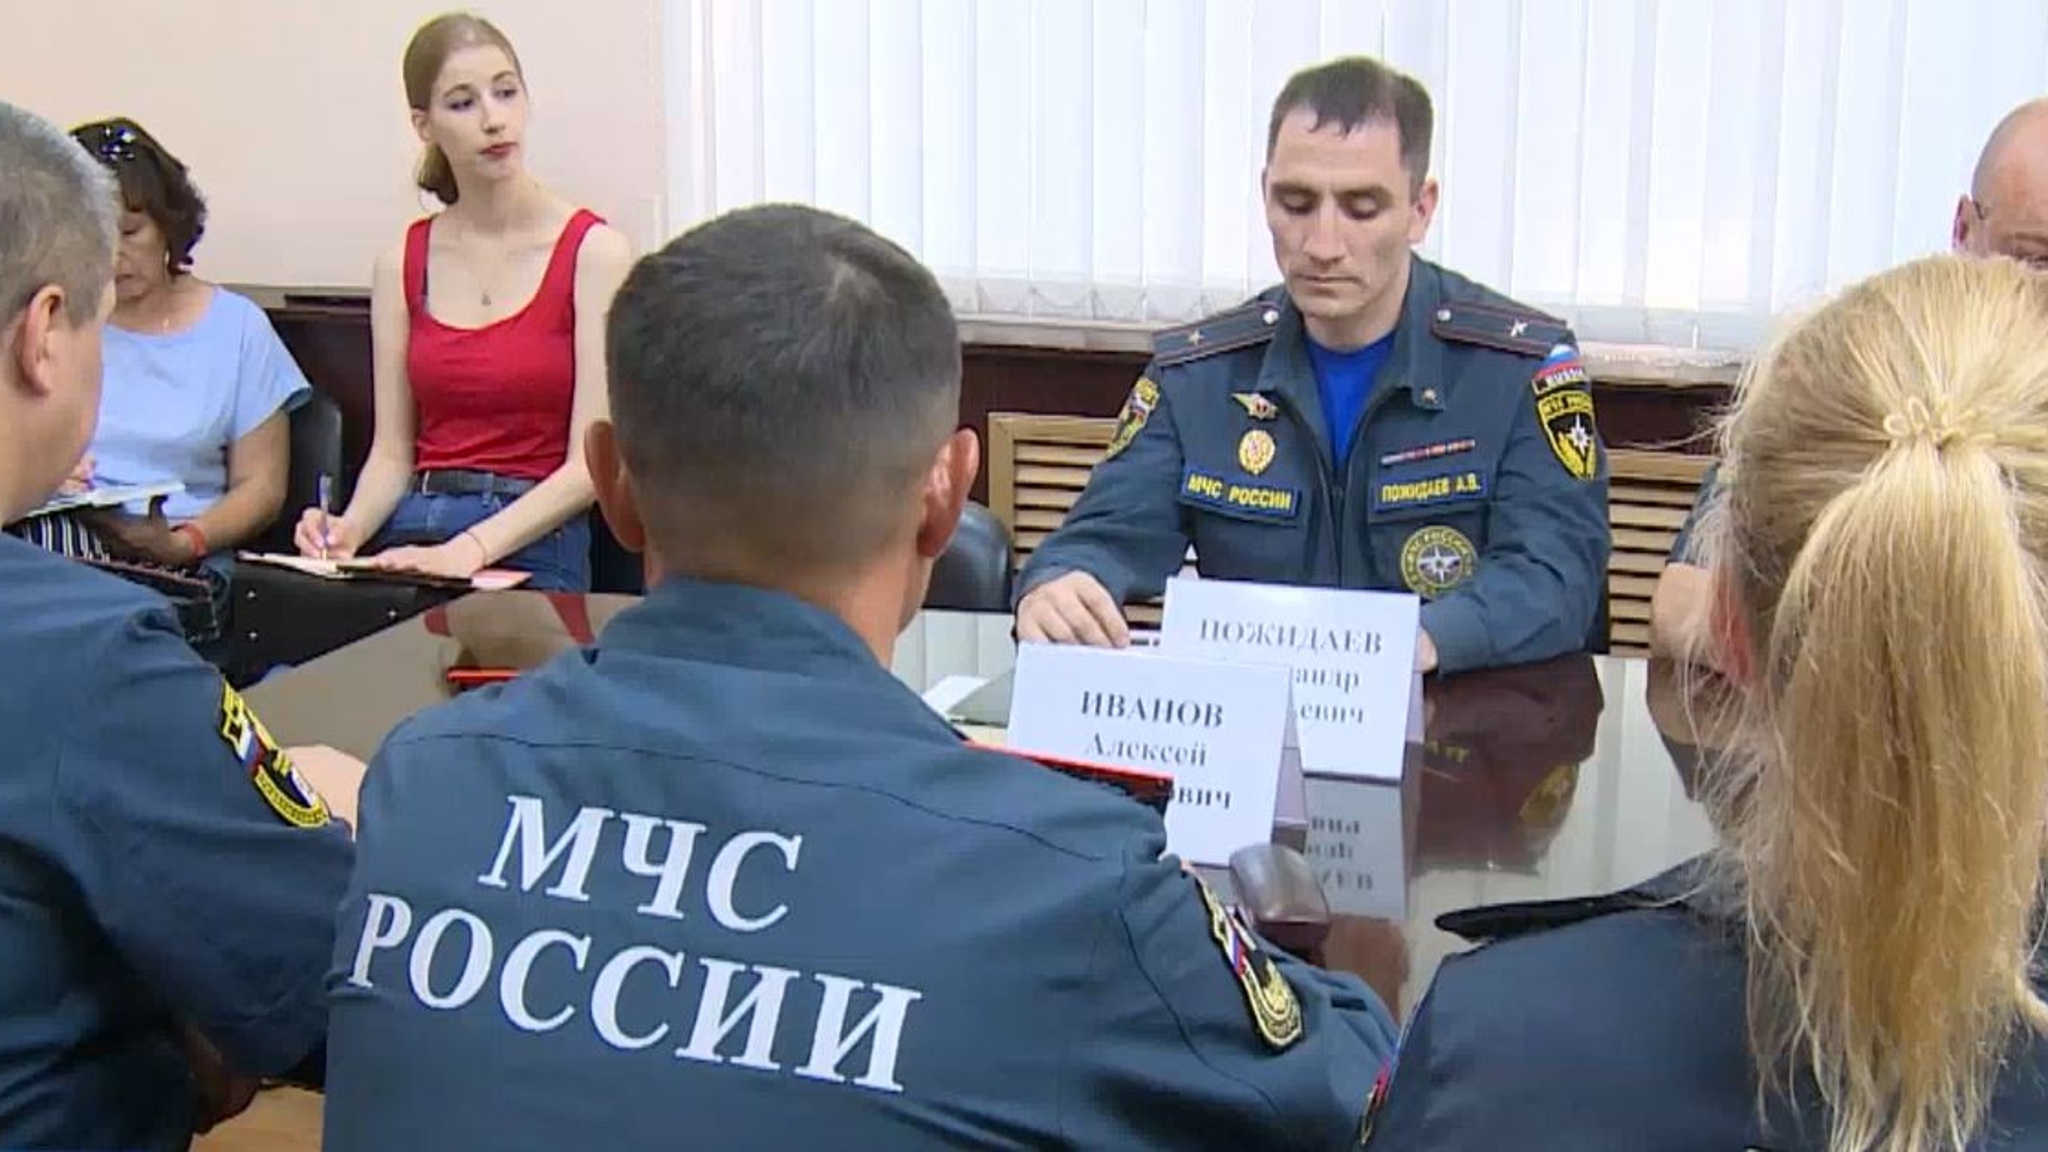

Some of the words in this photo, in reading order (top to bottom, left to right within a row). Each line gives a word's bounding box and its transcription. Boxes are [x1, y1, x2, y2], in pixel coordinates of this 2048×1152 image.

[1187, 473, 1223, 499] МЧС
[1228, 486, 1292, 511] РОССИИ
[1382, 477, 1450, 503] ПОЖИДАЕВ
[1200, 618, 1383, 655] ПОЖИДАЕВ
[1296, 667, 1360, 694] андр
[1080, 690, 1224, 728] ИВАНОВ
[1300, 702, 1364, 725] евич
[1083, 732, 1207, 767] Алексей
[1178, 786, 1231, 810] вич
[478, 795, 803, 933] МЧС
[347, 893, 922, 1093] РОССИИ
